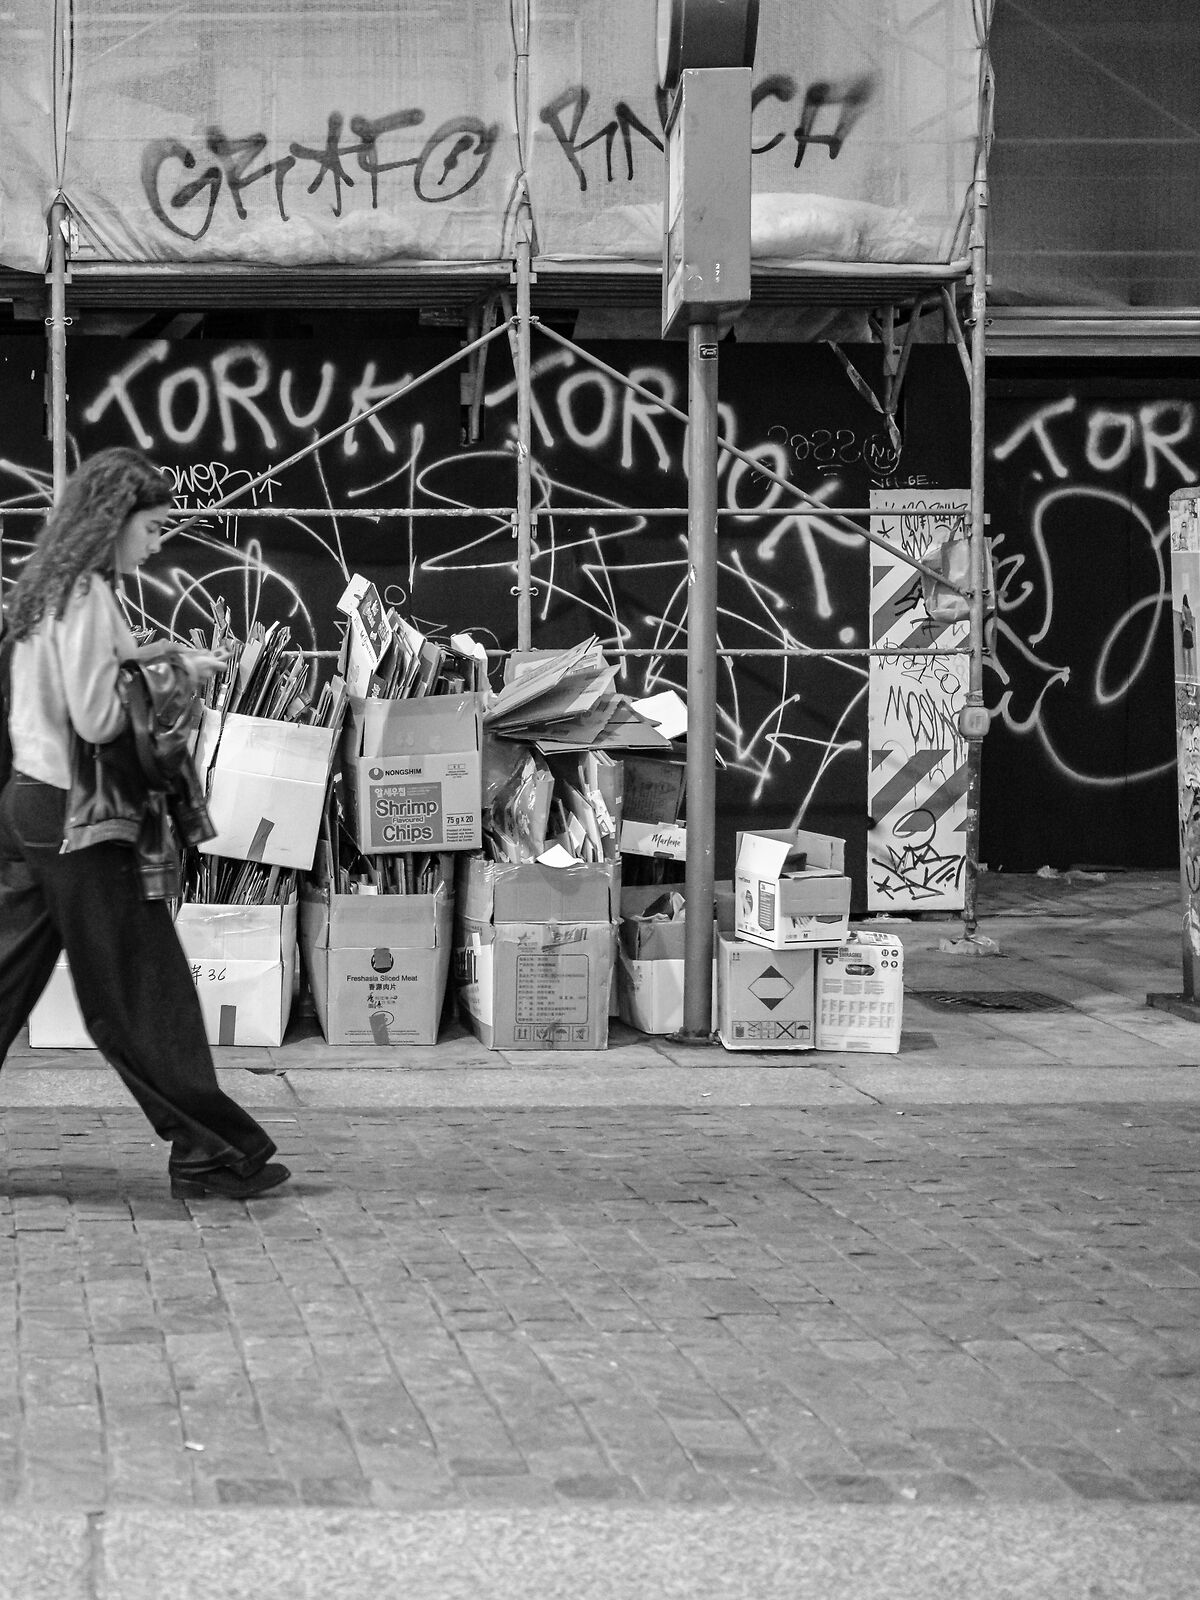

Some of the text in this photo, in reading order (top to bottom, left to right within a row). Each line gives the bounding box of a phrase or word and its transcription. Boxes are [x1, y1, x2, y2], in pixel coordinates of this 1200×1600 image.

[83, 338, 416, 457] TORUK
[384, 768, 422, 776] NONGSHIM
[376, 799, 439, 817] Shrimp
[392, 816, 424, 824] Flavoured
[446, 816, 454, 824] 75
[465, 815, 474, 823] 20
[383, 825, 433, 842] Chips
[208, 967, 227, 981] 36
[380, 974, 400, 982] Sliced
[401, 974, 418, 982] Meat
